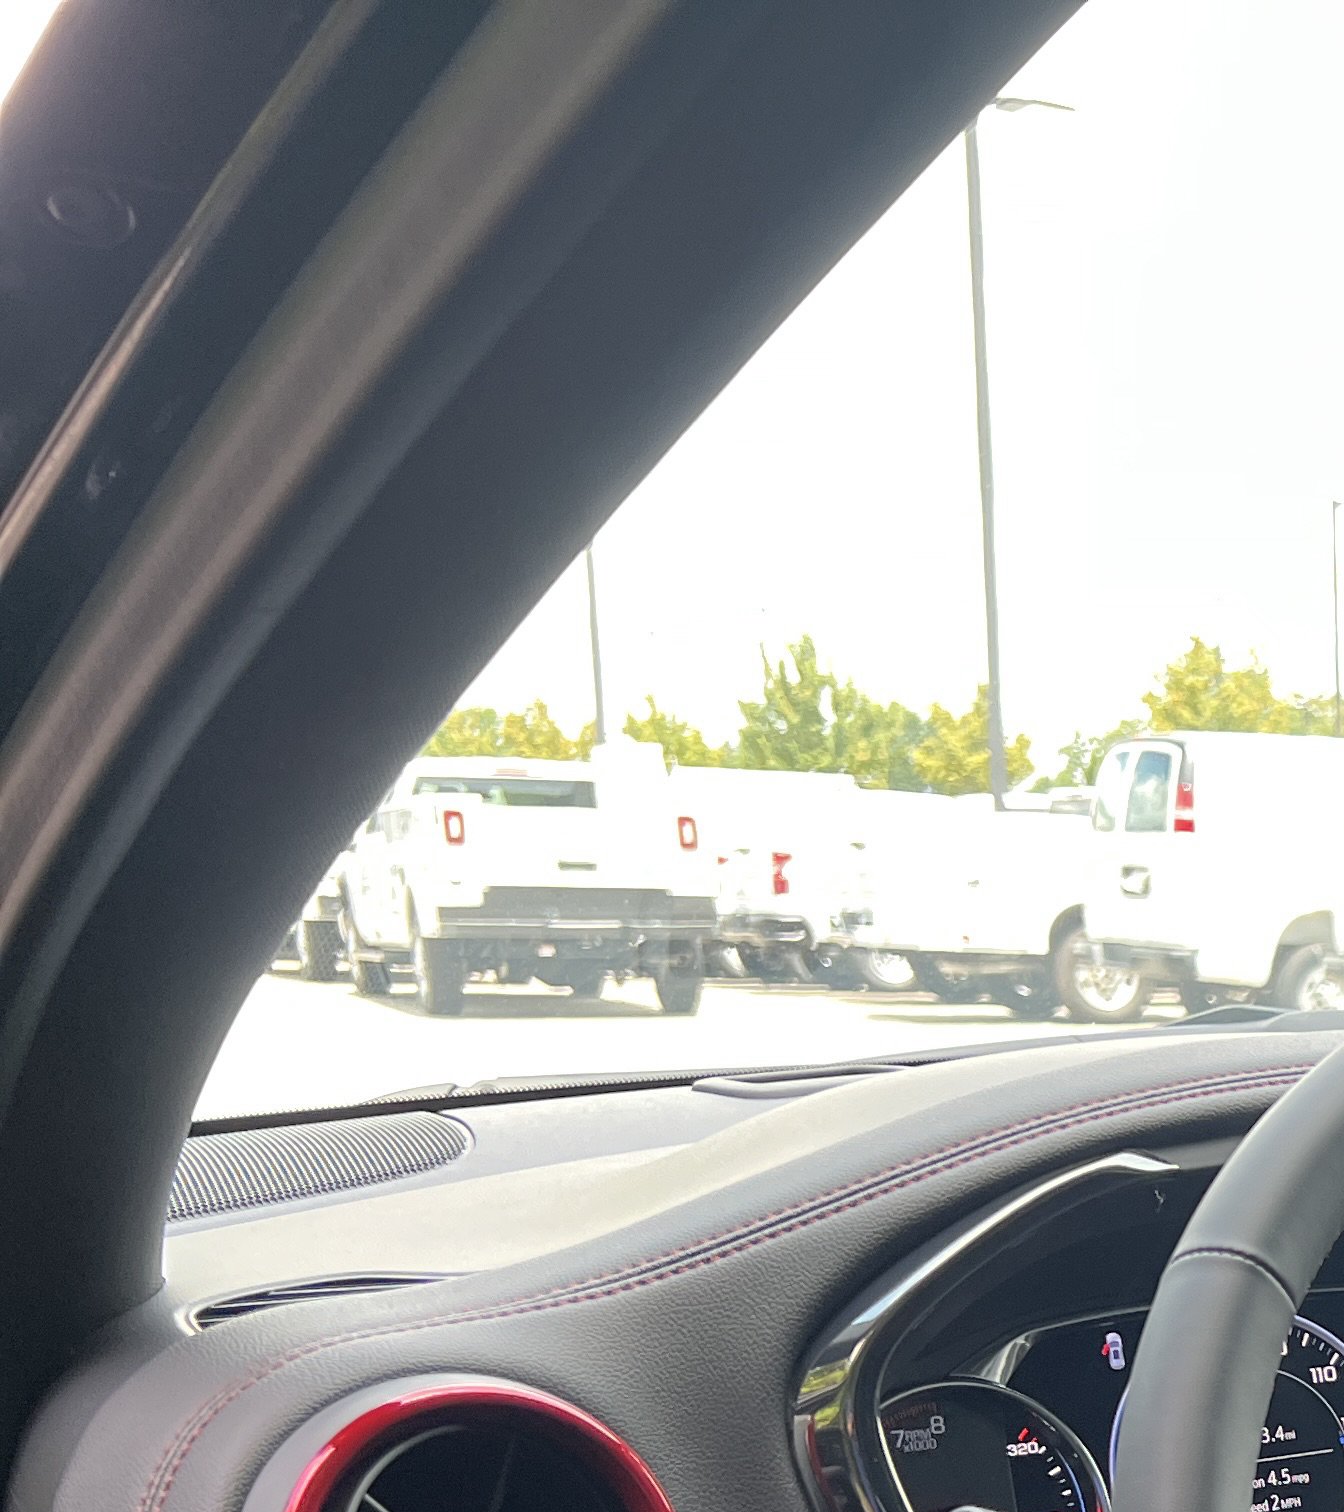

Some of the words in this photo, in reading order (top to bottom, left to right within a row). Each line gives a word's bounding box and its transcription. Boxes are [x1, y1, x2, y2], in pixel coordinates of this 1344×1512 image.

[1309, 1365, 1338, 1384] 110
[929, 1415, 946, 1435] 8
[890, 1429, 905, 1448] 7
[1006, 1441, 1039, 1457] 320
